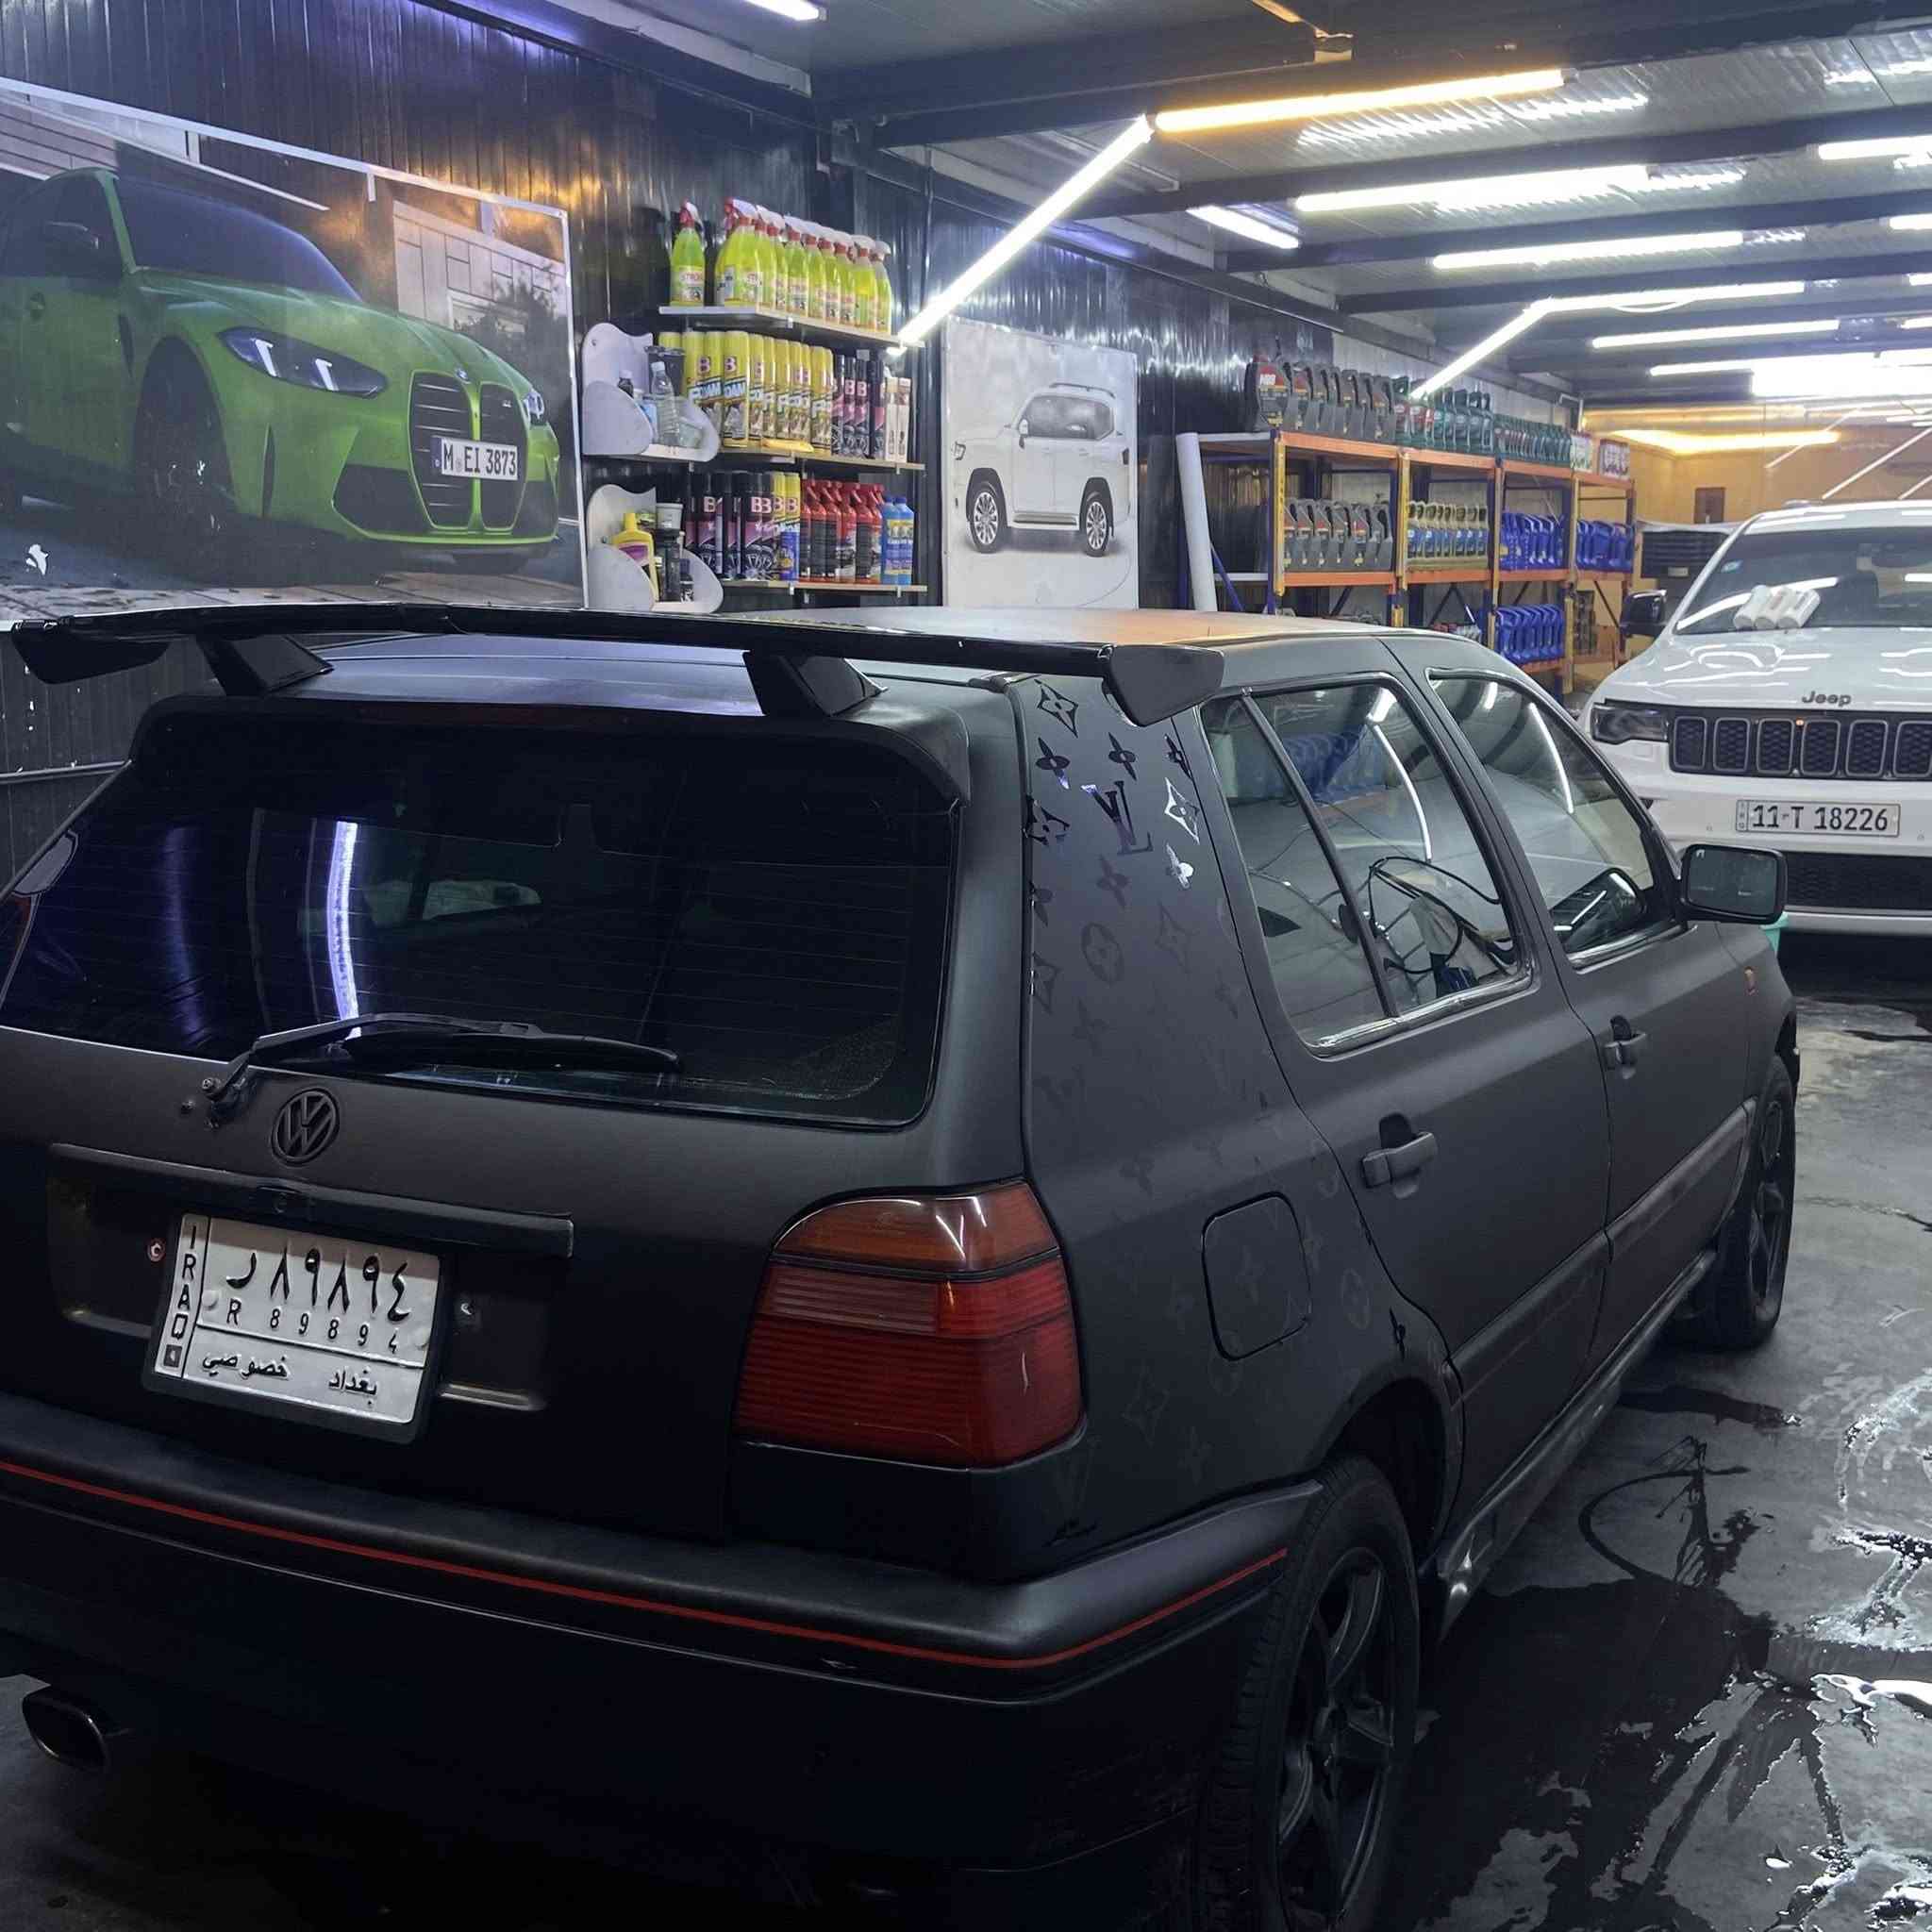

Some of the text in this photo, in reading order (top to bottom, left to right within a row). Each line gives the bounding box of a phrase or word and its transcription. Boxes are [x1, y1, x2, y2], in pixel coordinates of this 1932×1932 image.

[486, 449, 516, 475] 3873
[704, 496, 716, 512] B
[1802, 691, 1851, 708] Jeep
[1813, 807, 1888, 831] 18226
[171, 1224, 197, 1341] IRAQ
[202, 1355, 377, 1405] بغداد خصوصي
